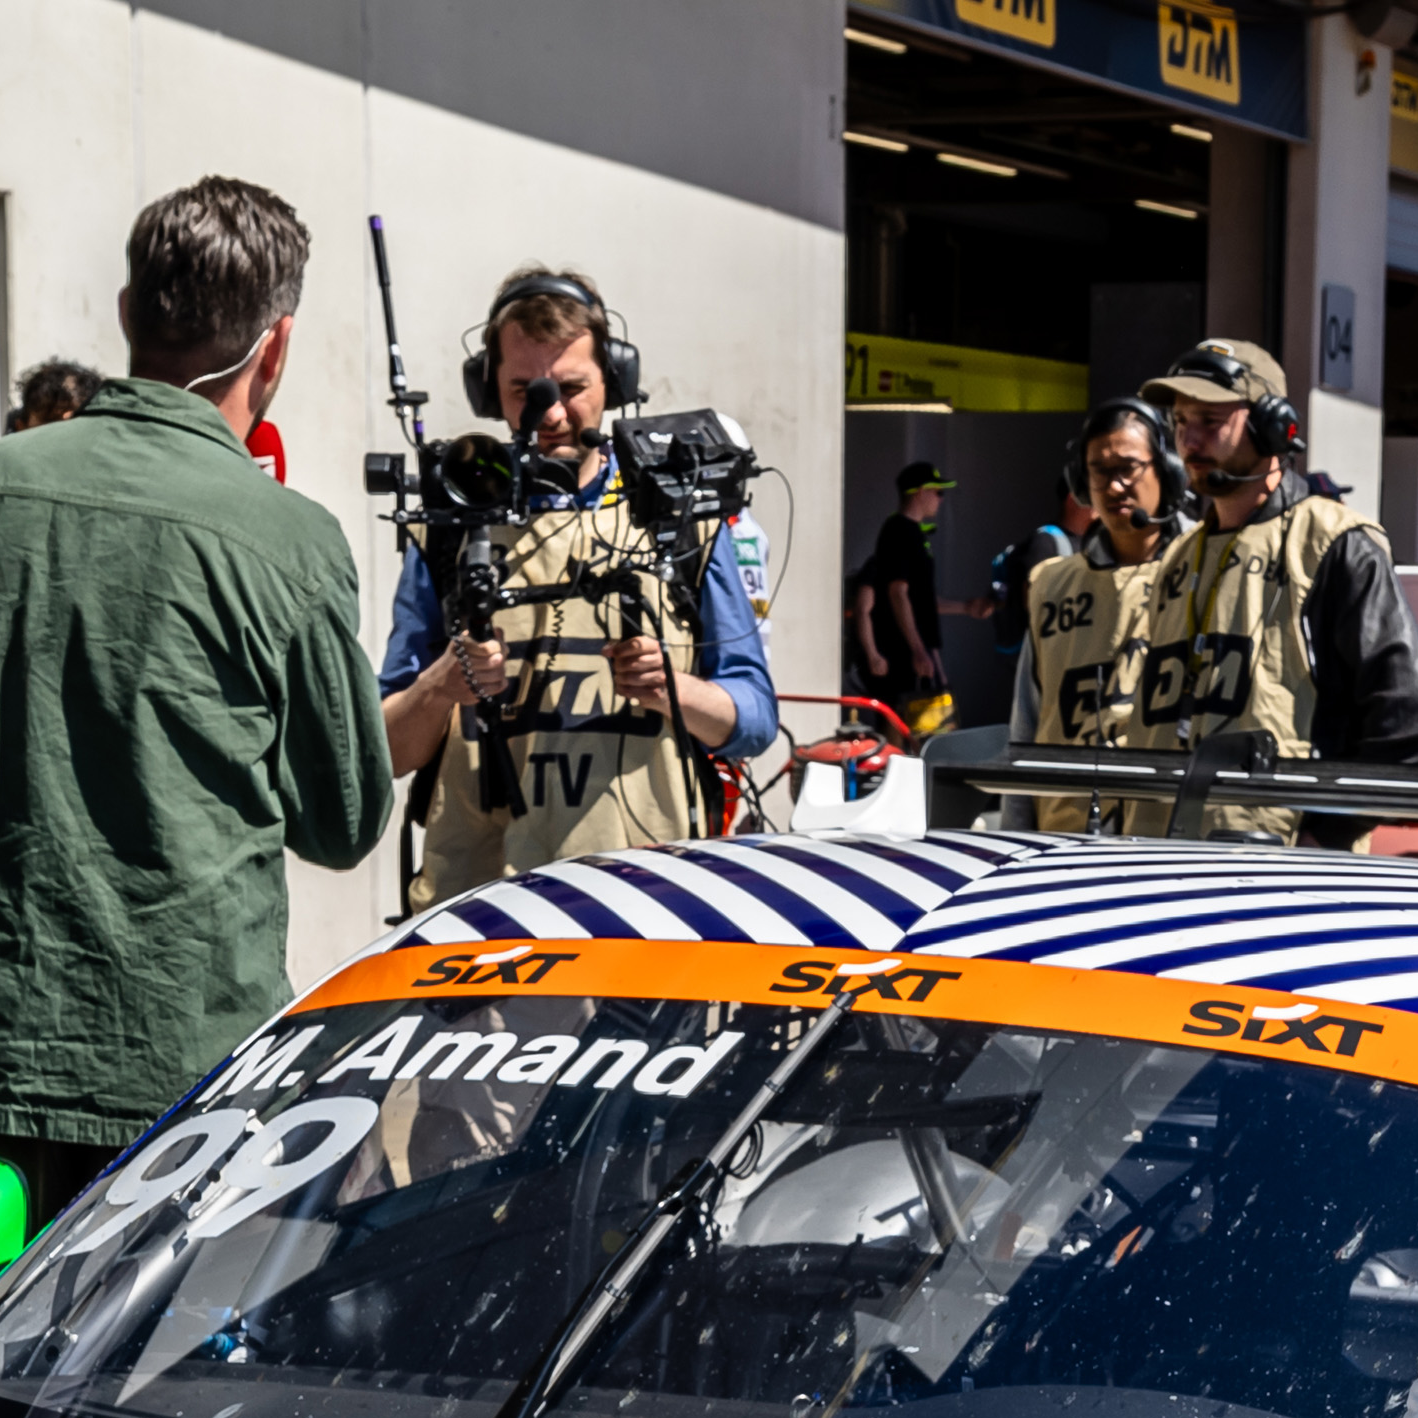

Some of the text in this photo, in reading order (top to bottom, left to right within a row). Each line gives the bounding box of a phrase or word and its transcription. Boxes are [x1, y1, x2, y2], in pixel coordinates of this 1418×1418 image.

[1040, 591, 1094, 638] 262
[528, 752, 593, 807] TV
[325, 1015, 745, 1099] Amand
